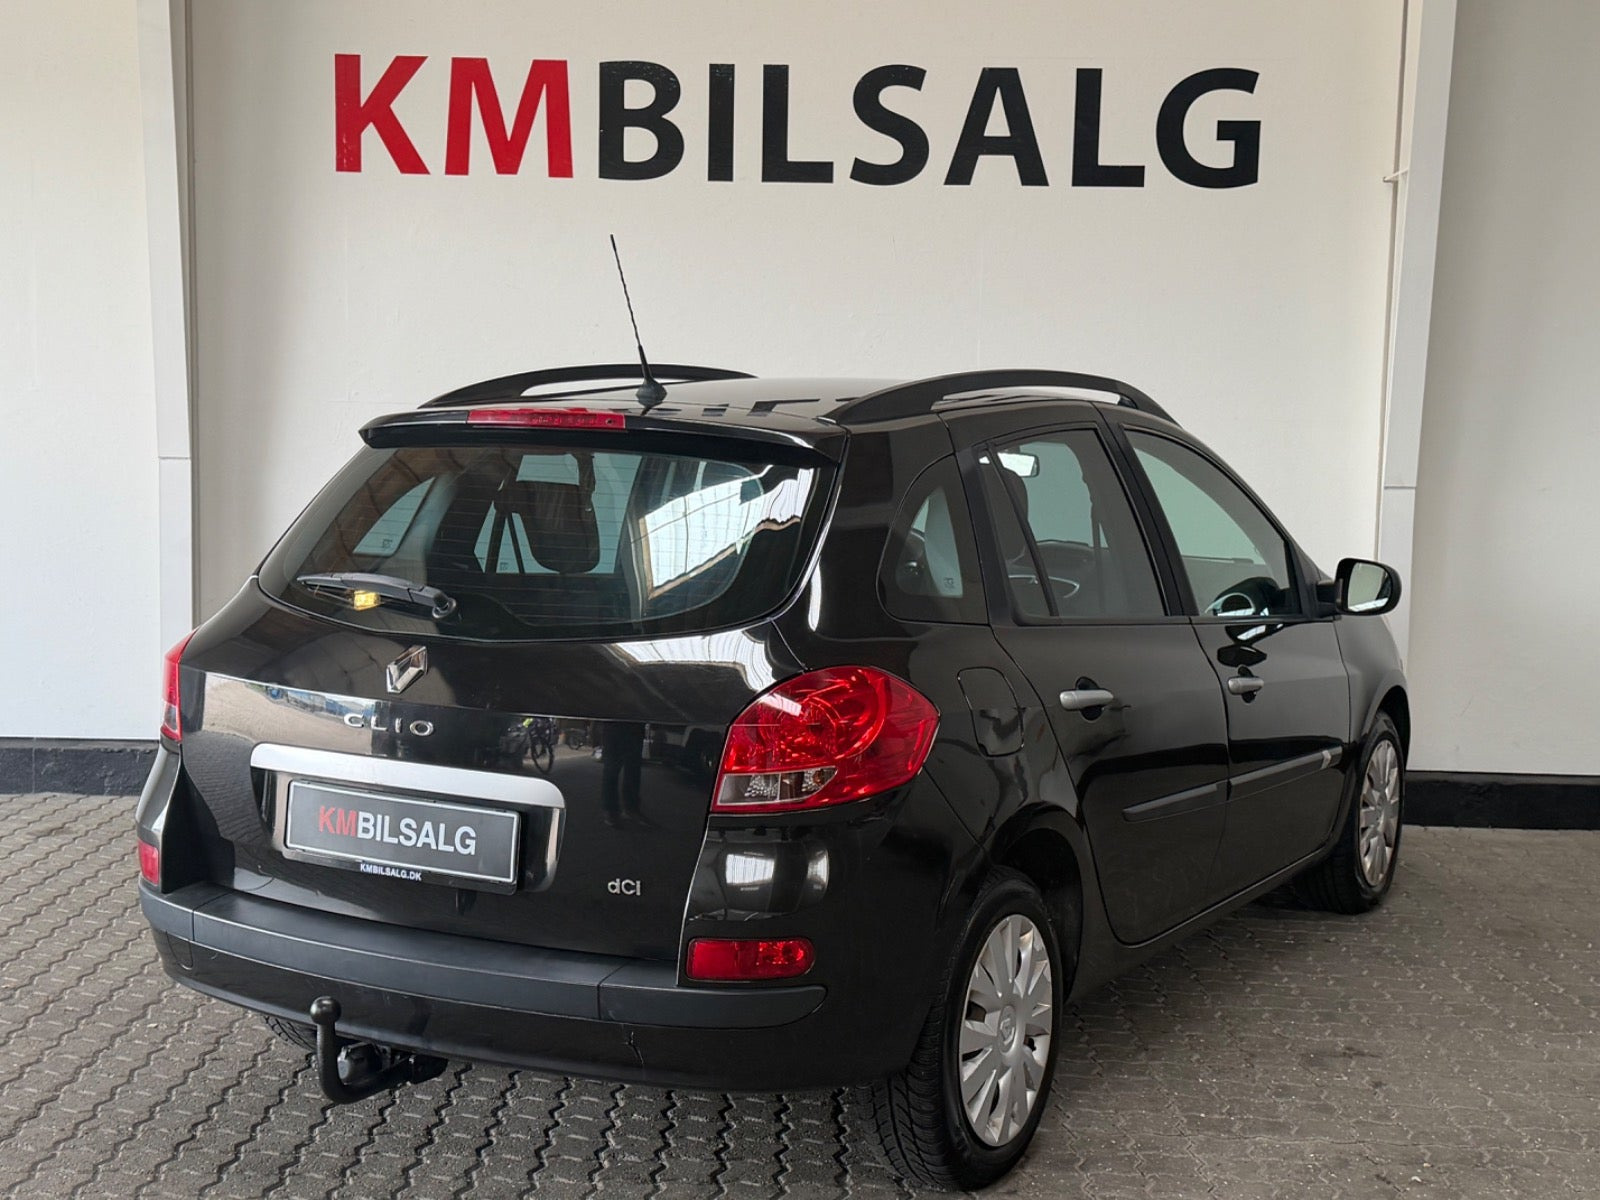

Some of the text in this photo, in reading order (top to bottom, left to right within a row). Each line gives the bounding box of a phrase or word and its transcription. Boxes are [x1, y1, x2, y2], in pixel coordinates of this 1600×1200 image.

[334, 53, 1261, 188] KMBILSALG
[343, 712, 434, 736] CLIO
[318, 805, 477, 856] KMBILSALG
[359, 862, 422, 882] KMBILSALG.DK
